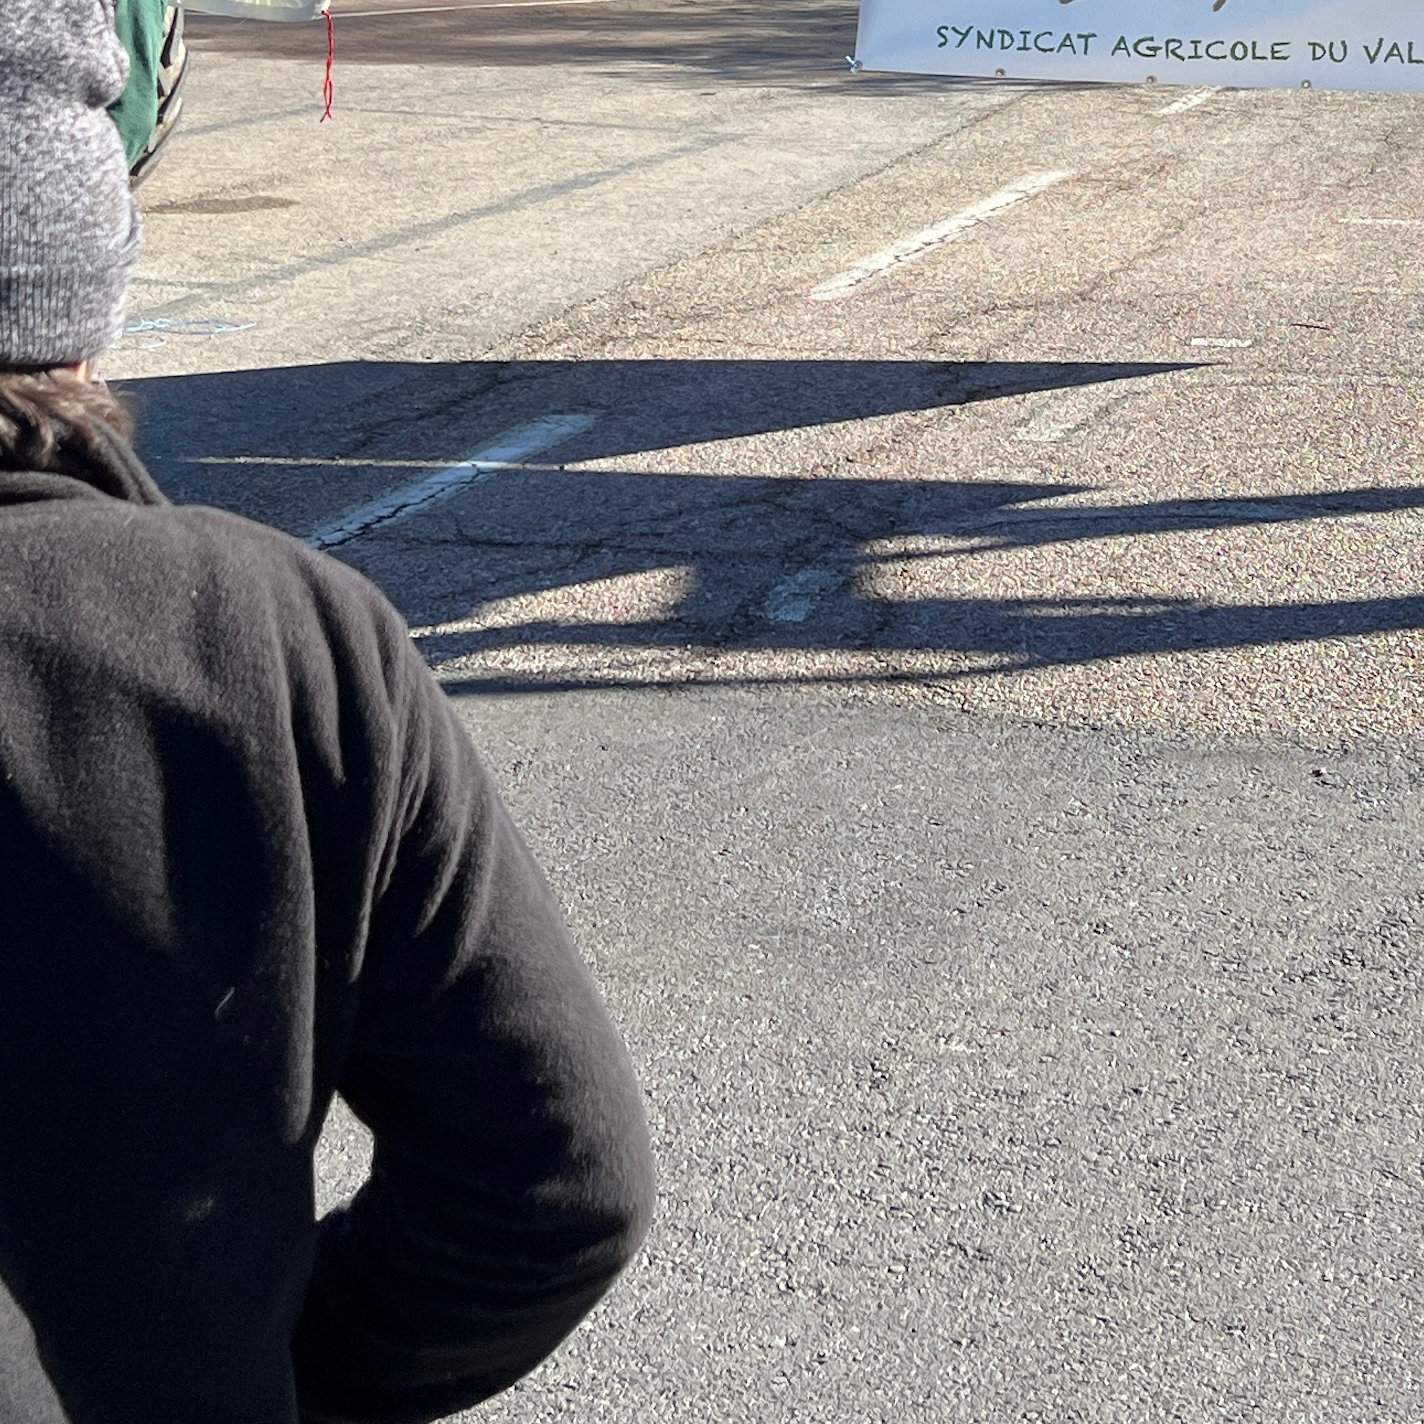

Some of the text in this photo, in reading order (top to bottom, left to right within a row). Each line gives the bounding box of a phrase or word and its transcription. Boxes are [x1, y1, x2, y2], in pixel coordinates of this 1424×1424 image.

[936, 24, 1097, 56] SYNDICAT
[1110, 35, 1291, 62] AGRICOLE
[1307, 39, 1348, 63] DU
